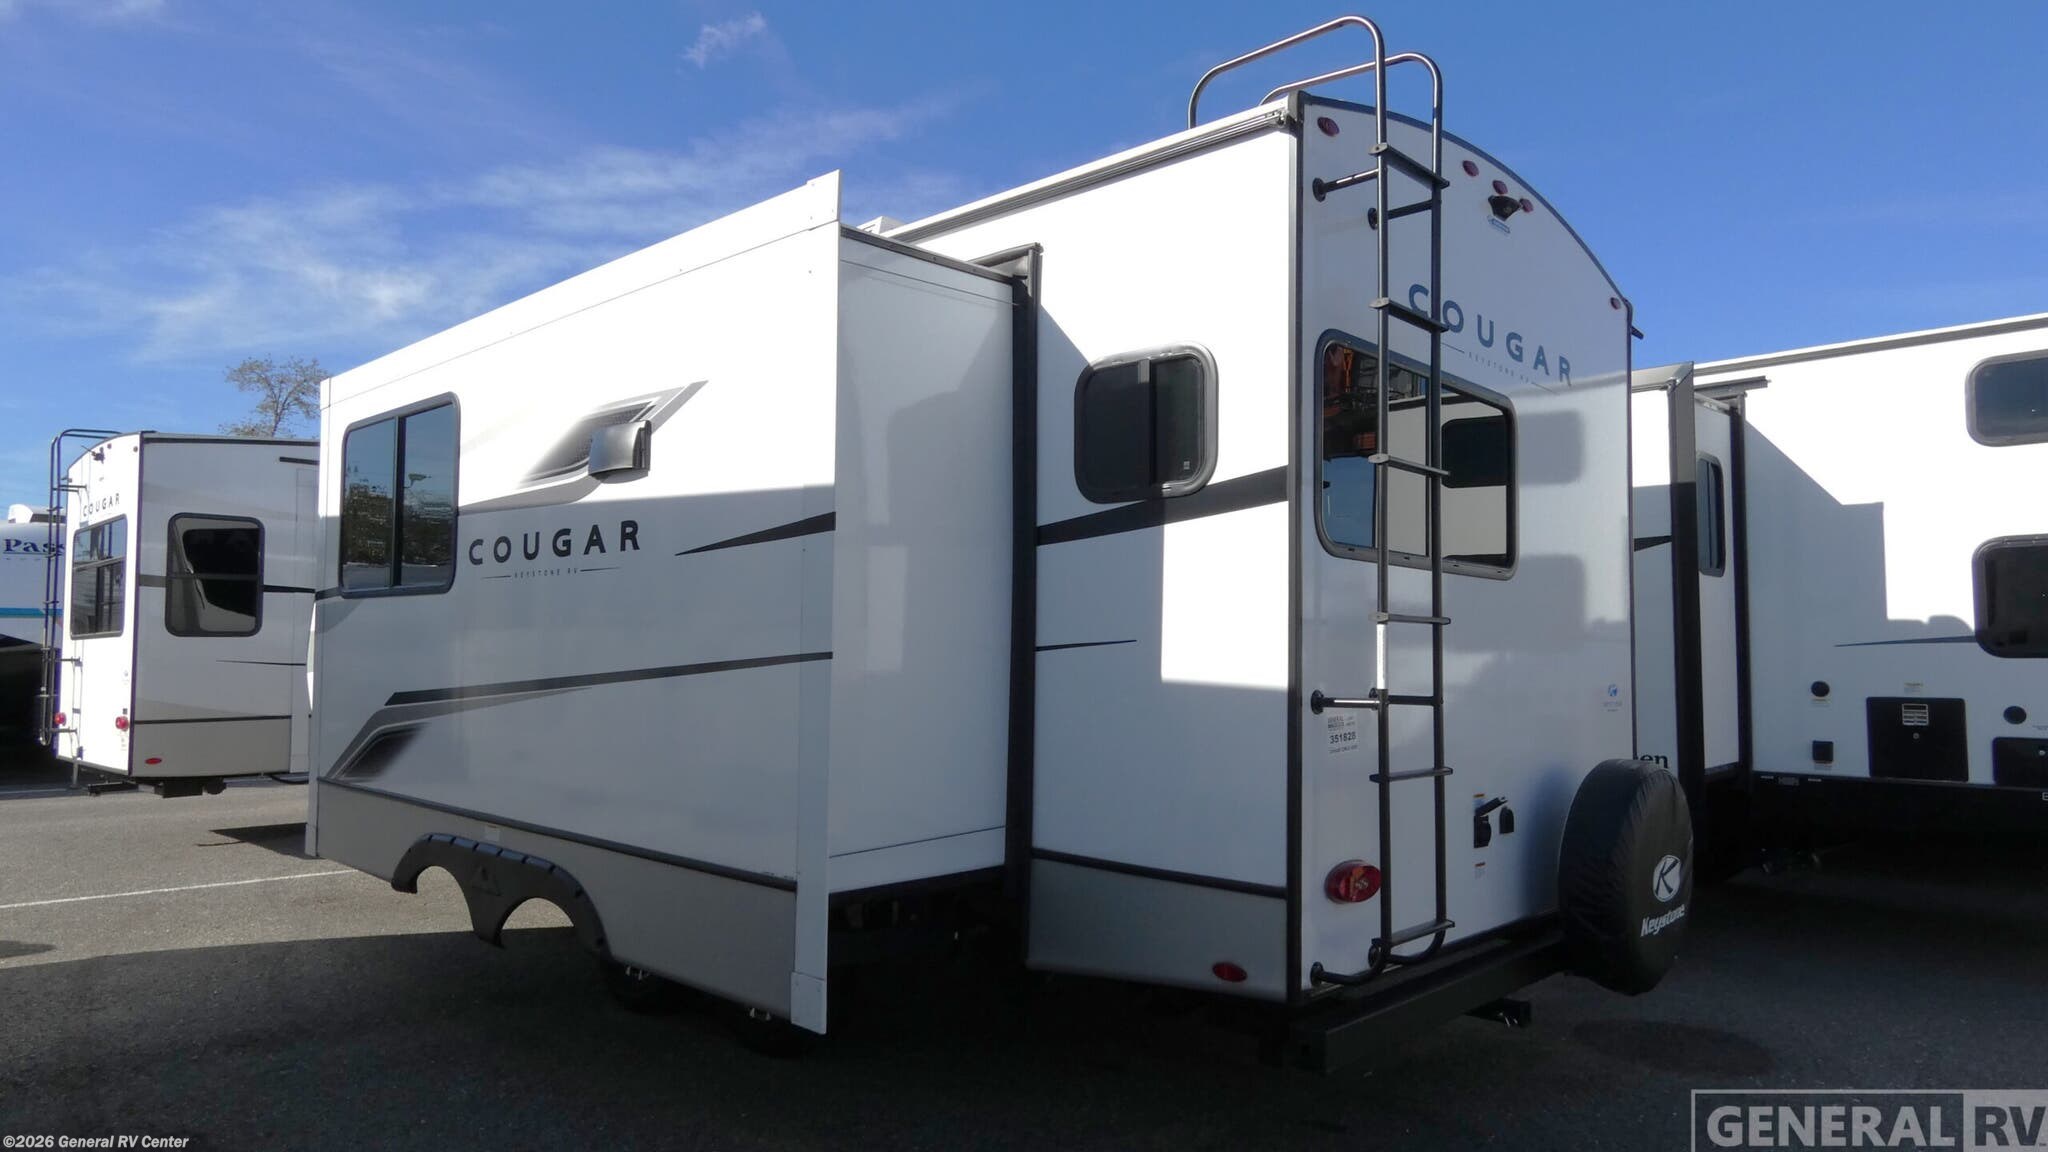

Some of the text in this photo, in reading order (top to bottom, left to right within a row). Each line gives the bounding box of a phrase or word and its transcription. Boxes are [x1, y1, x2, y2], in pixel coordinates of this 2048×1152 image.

[1408, 283, 1572, 387] COUGAR
[83, 492, 120, 517] COUGAR
[468, 519, 641, 566] COUGAR
[1640, 903, 1685, 937] Keystone
